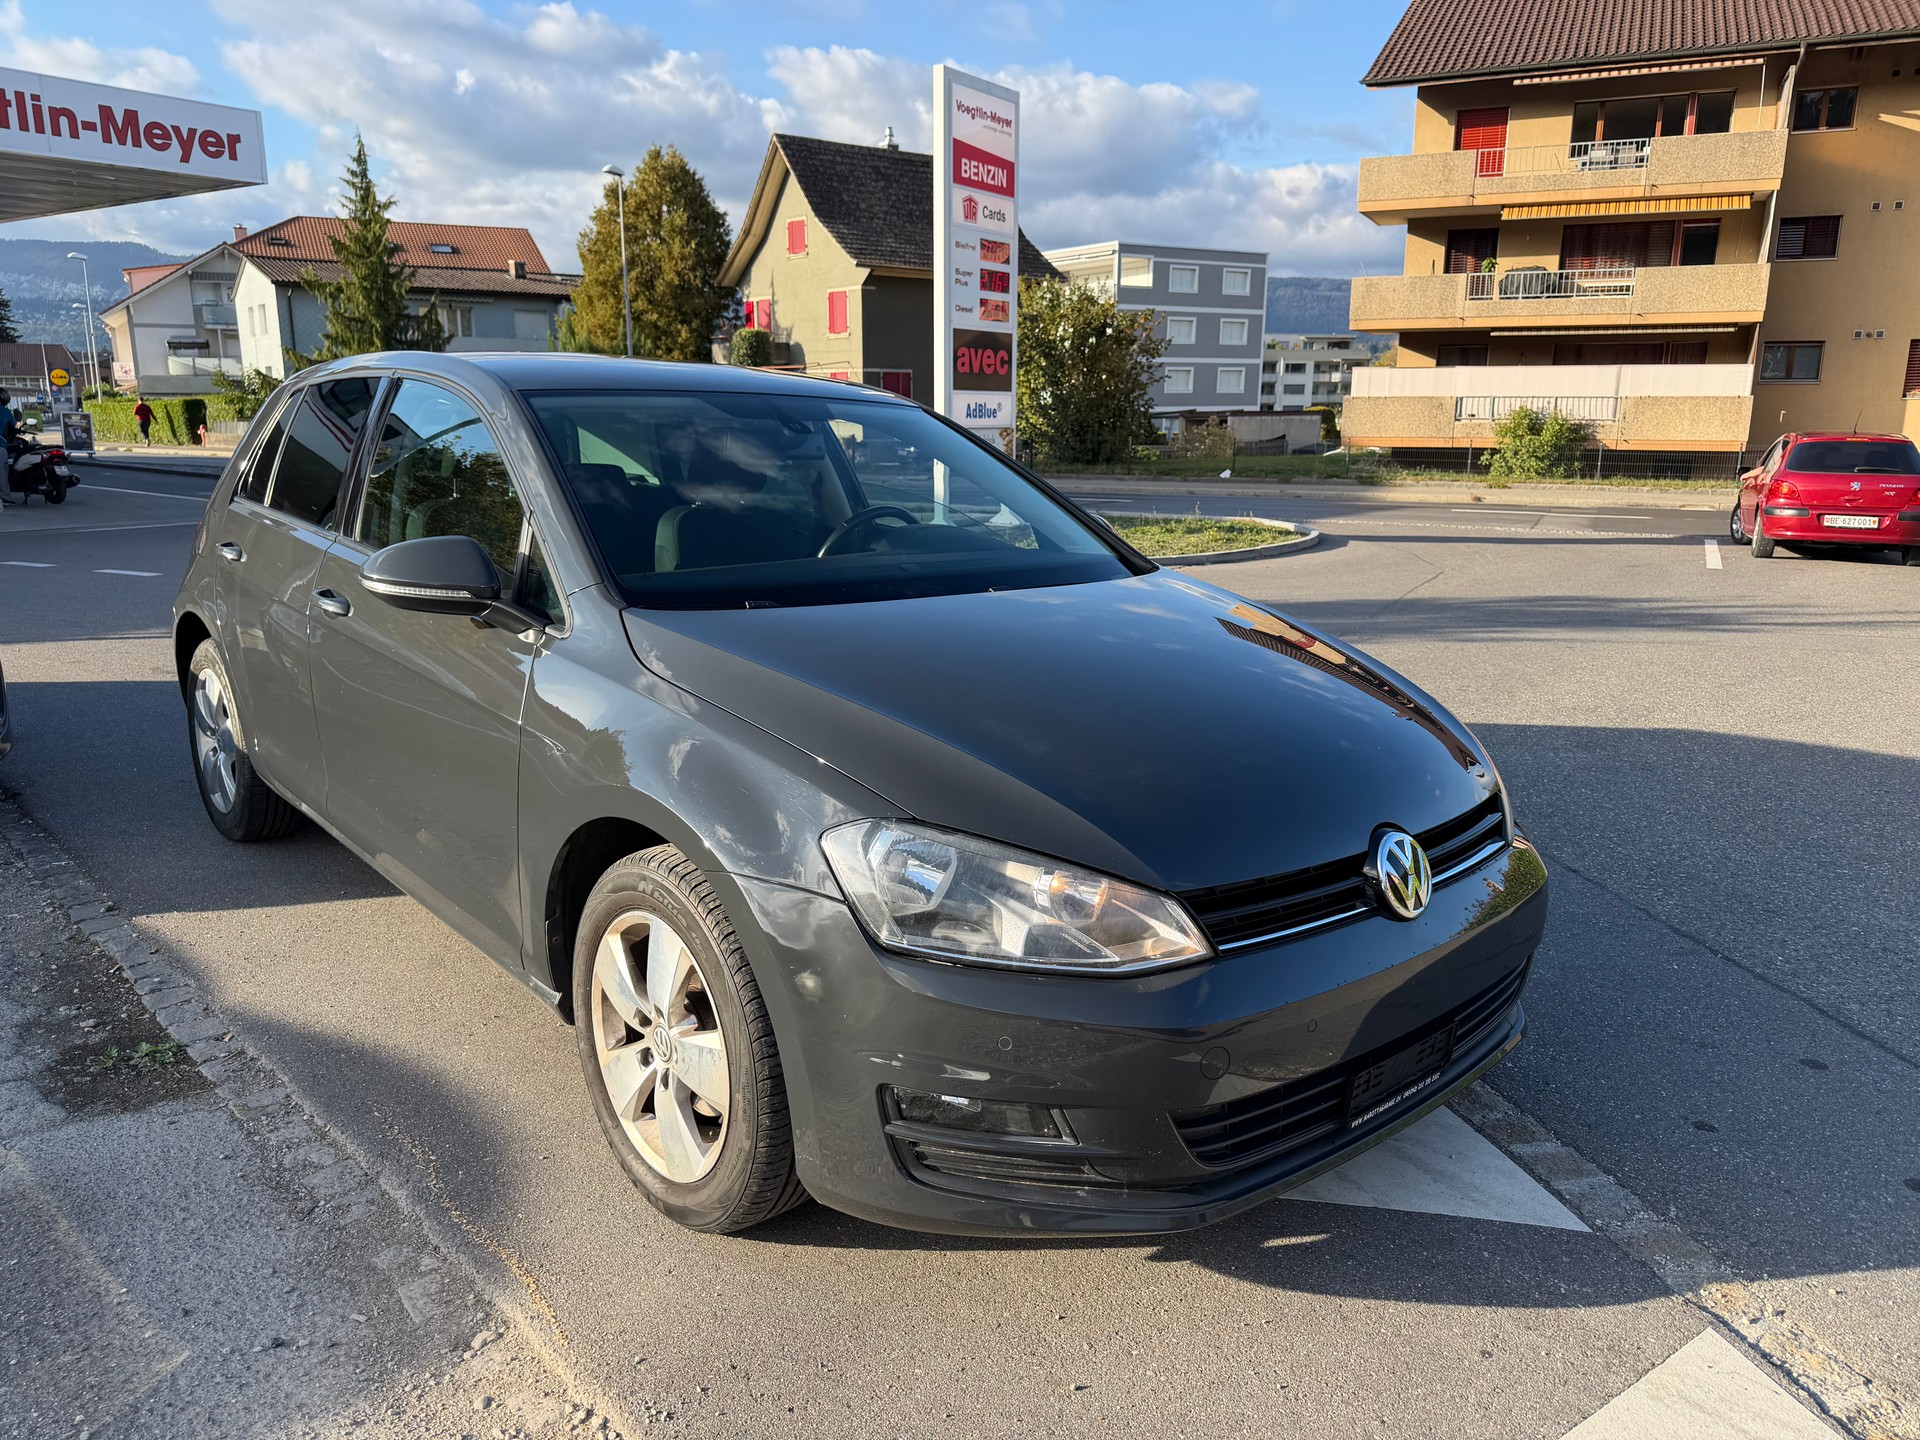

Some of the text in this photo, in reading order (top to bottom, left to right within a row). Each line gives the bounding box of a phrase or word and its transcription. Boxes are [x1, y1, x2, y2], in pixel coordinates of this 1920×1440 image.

[956, 98, 1012, 129] Voegtlin-Meyer
[961, 157, 1007, 188] BENZIN
[982, 205, 1006, 223] Cards
[955, 267, 973, 277] Super
[955, 278, 969, 287] Plus
[955, 304, 973, 313] Diesel
[956, 346, 1009, 376] avec
